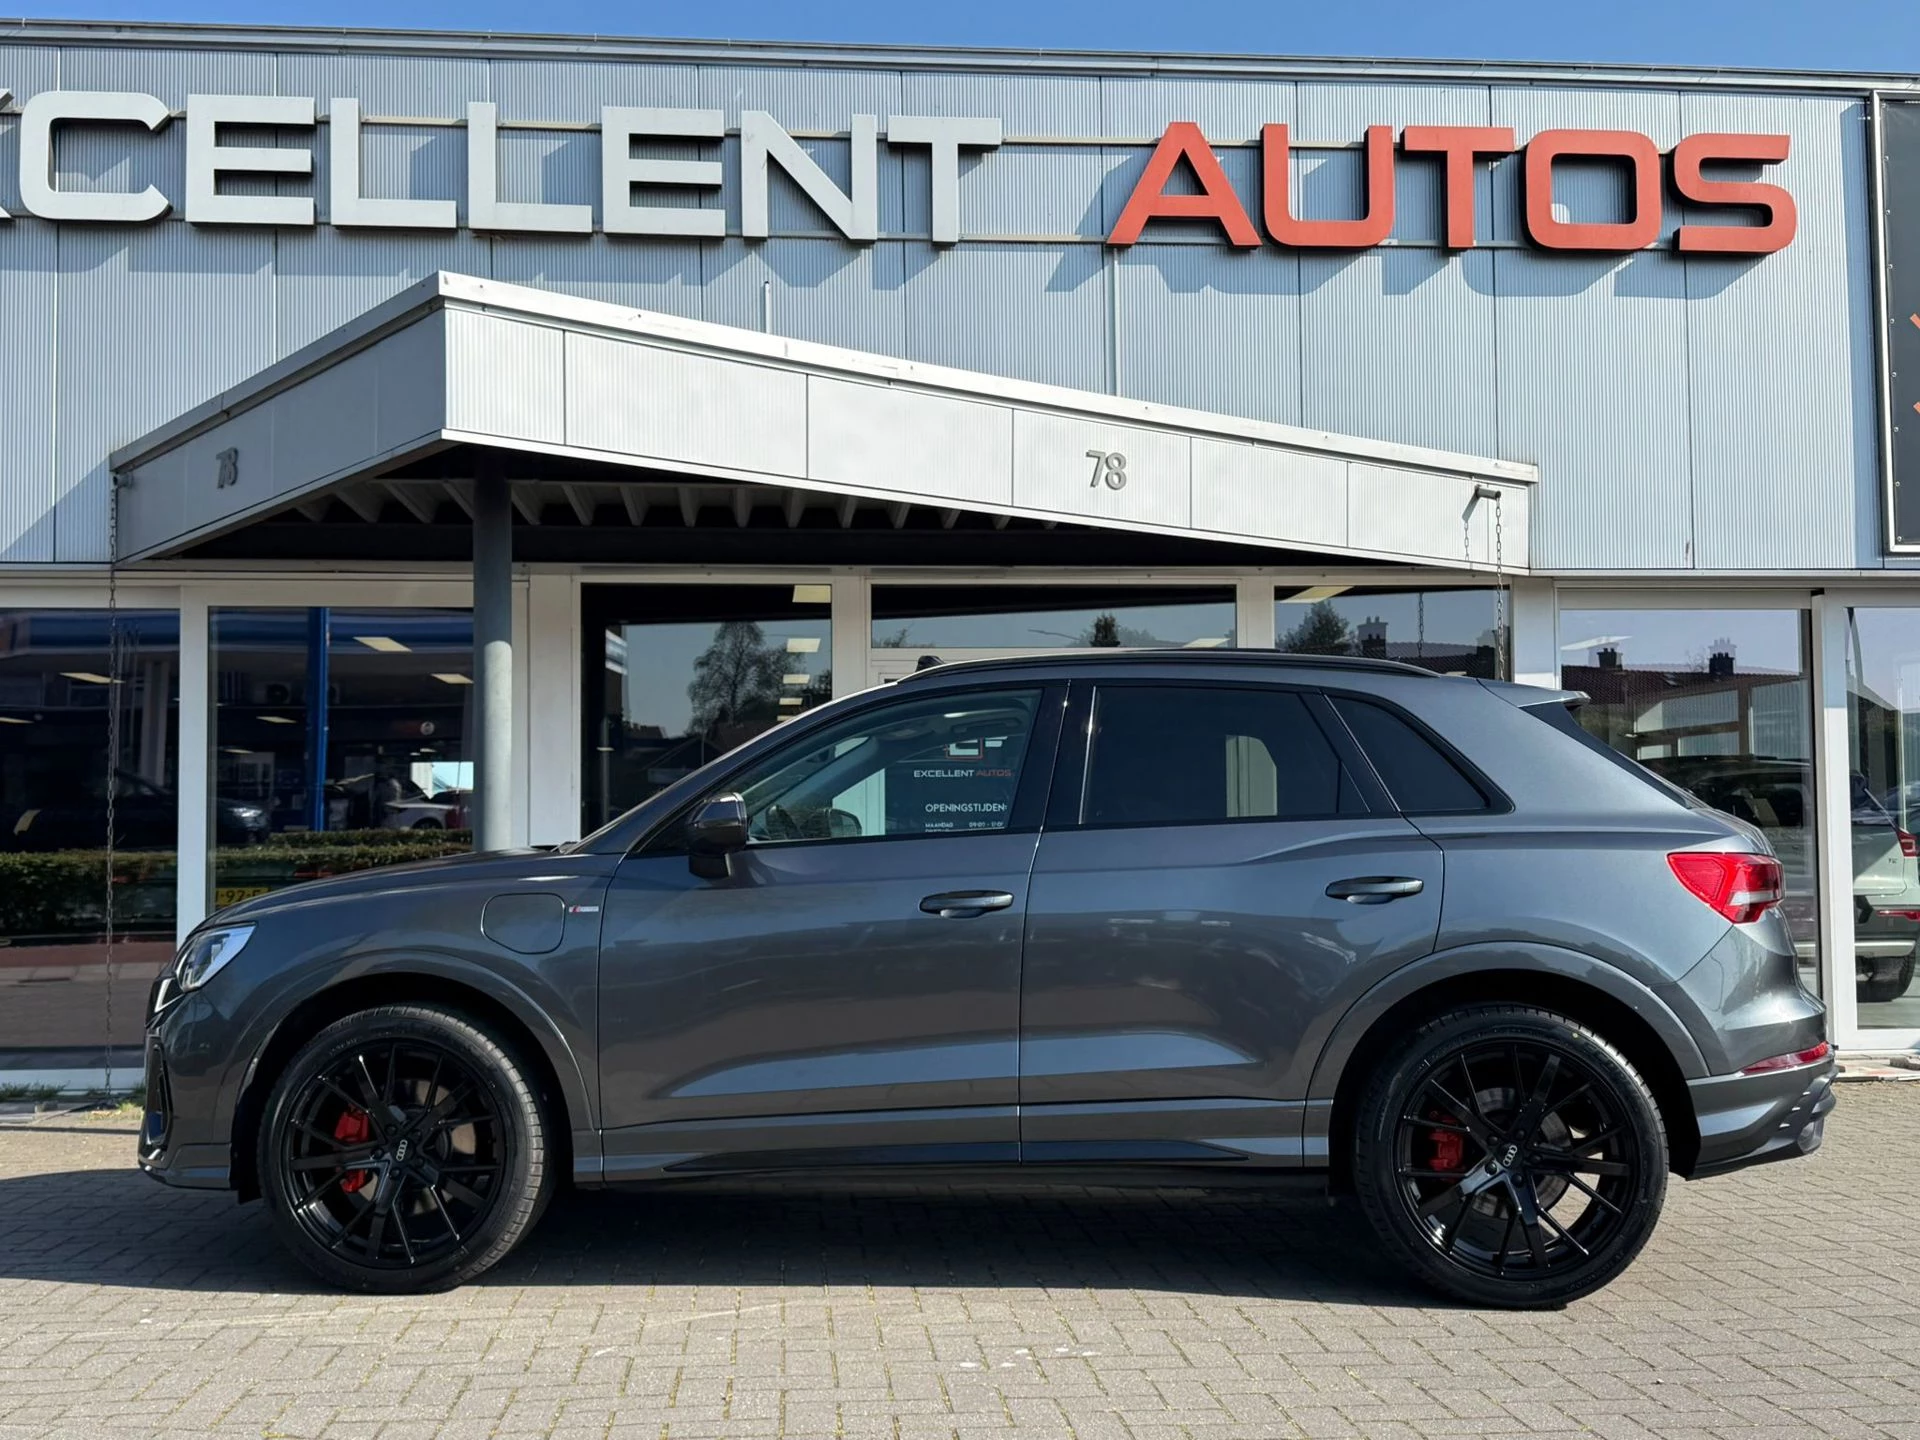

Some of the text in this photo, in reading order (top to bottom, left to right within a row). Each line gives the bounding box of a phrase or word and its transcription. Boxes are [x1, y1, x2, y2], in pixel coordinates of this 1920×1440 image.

[0, 88, 1798, 255] CELLENT AUTOS
[1085, 449, 1127, 491] 78
[913, 769, 1012, 778] EXCELLENT AUTOS
